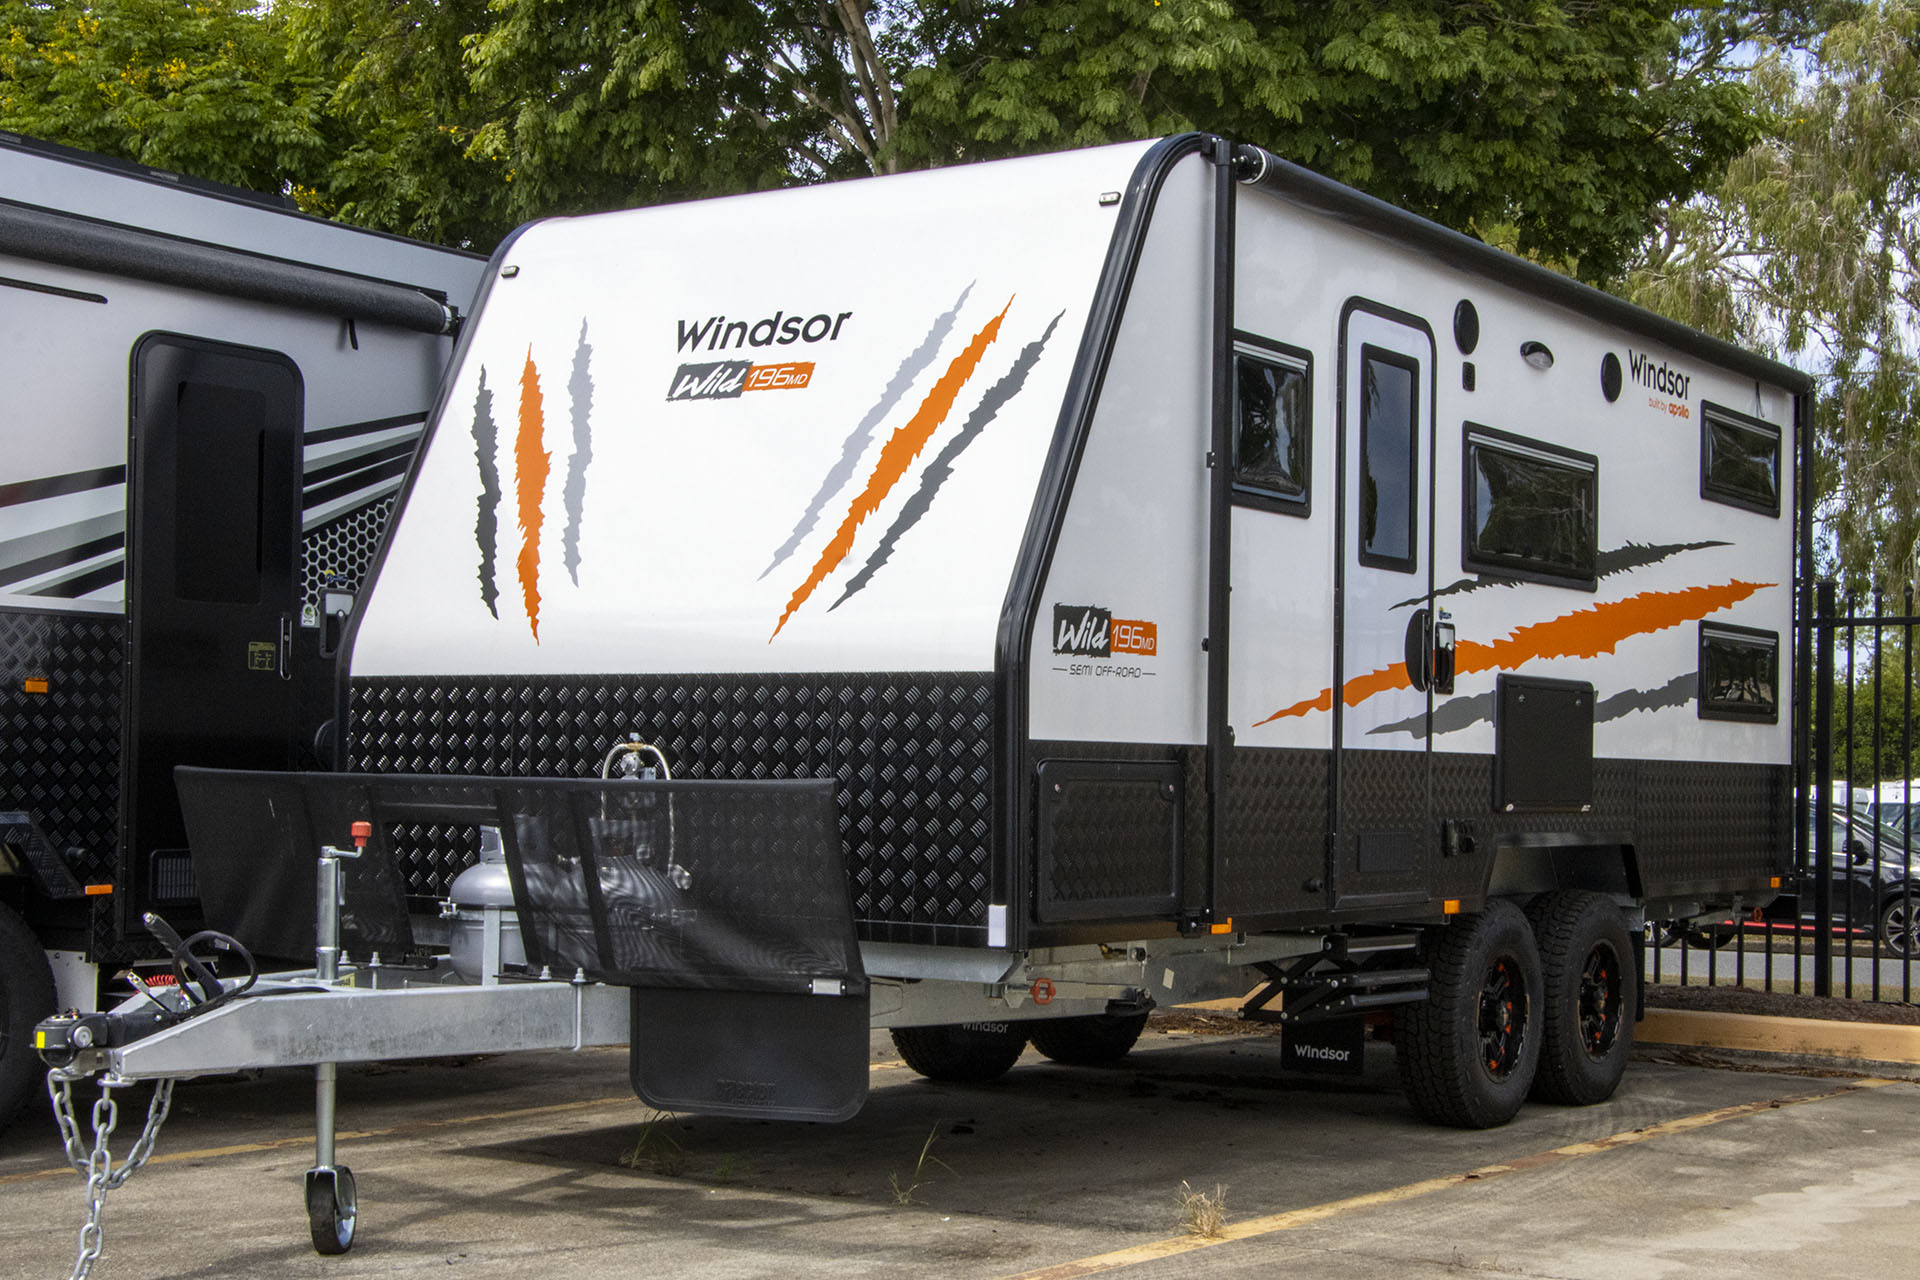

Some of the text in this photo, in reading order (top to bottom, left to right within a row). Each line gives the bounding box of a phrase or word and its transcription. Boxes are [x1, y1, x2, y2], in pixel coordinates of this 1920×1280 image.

[677, 311, 853, 354] Windsor
[672, 363, 808, 397] Wild 196MD
[1628, 348, 1691, 401] Windsor
[1648, 397, 1690, 419] built by apollo
[1057, 609, 1155, 651] Wild 196MD
[1069, 663, 1142, 679] SEMI OFF-ROAD
[1294, 1043, 1351, 1062] Windsor
